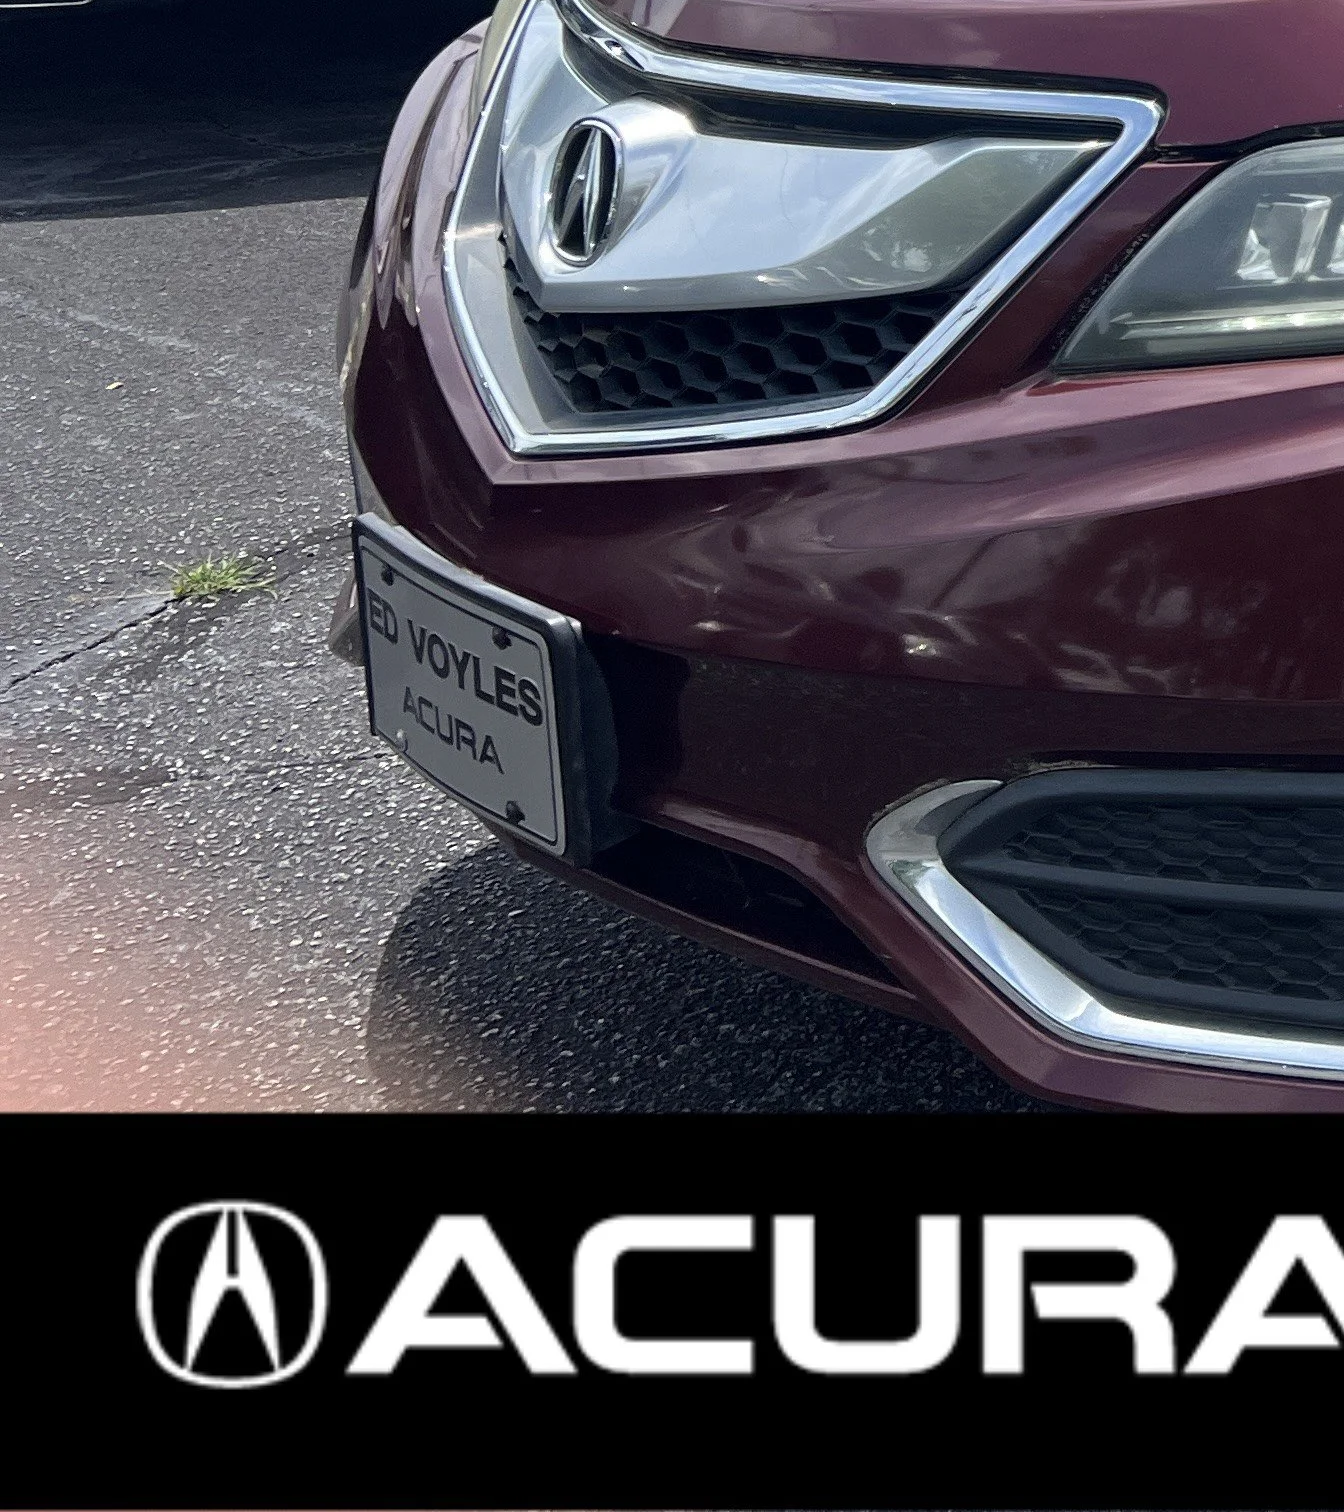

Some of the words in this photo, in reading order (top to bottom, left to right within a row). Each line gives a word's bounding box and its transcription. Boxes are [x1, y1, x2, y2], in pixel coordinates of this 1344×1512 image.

[368, 589, 399, 645] ED
[407, 617, 544, 727] VOYLES
[403, 685, 505, 775] ACURA
